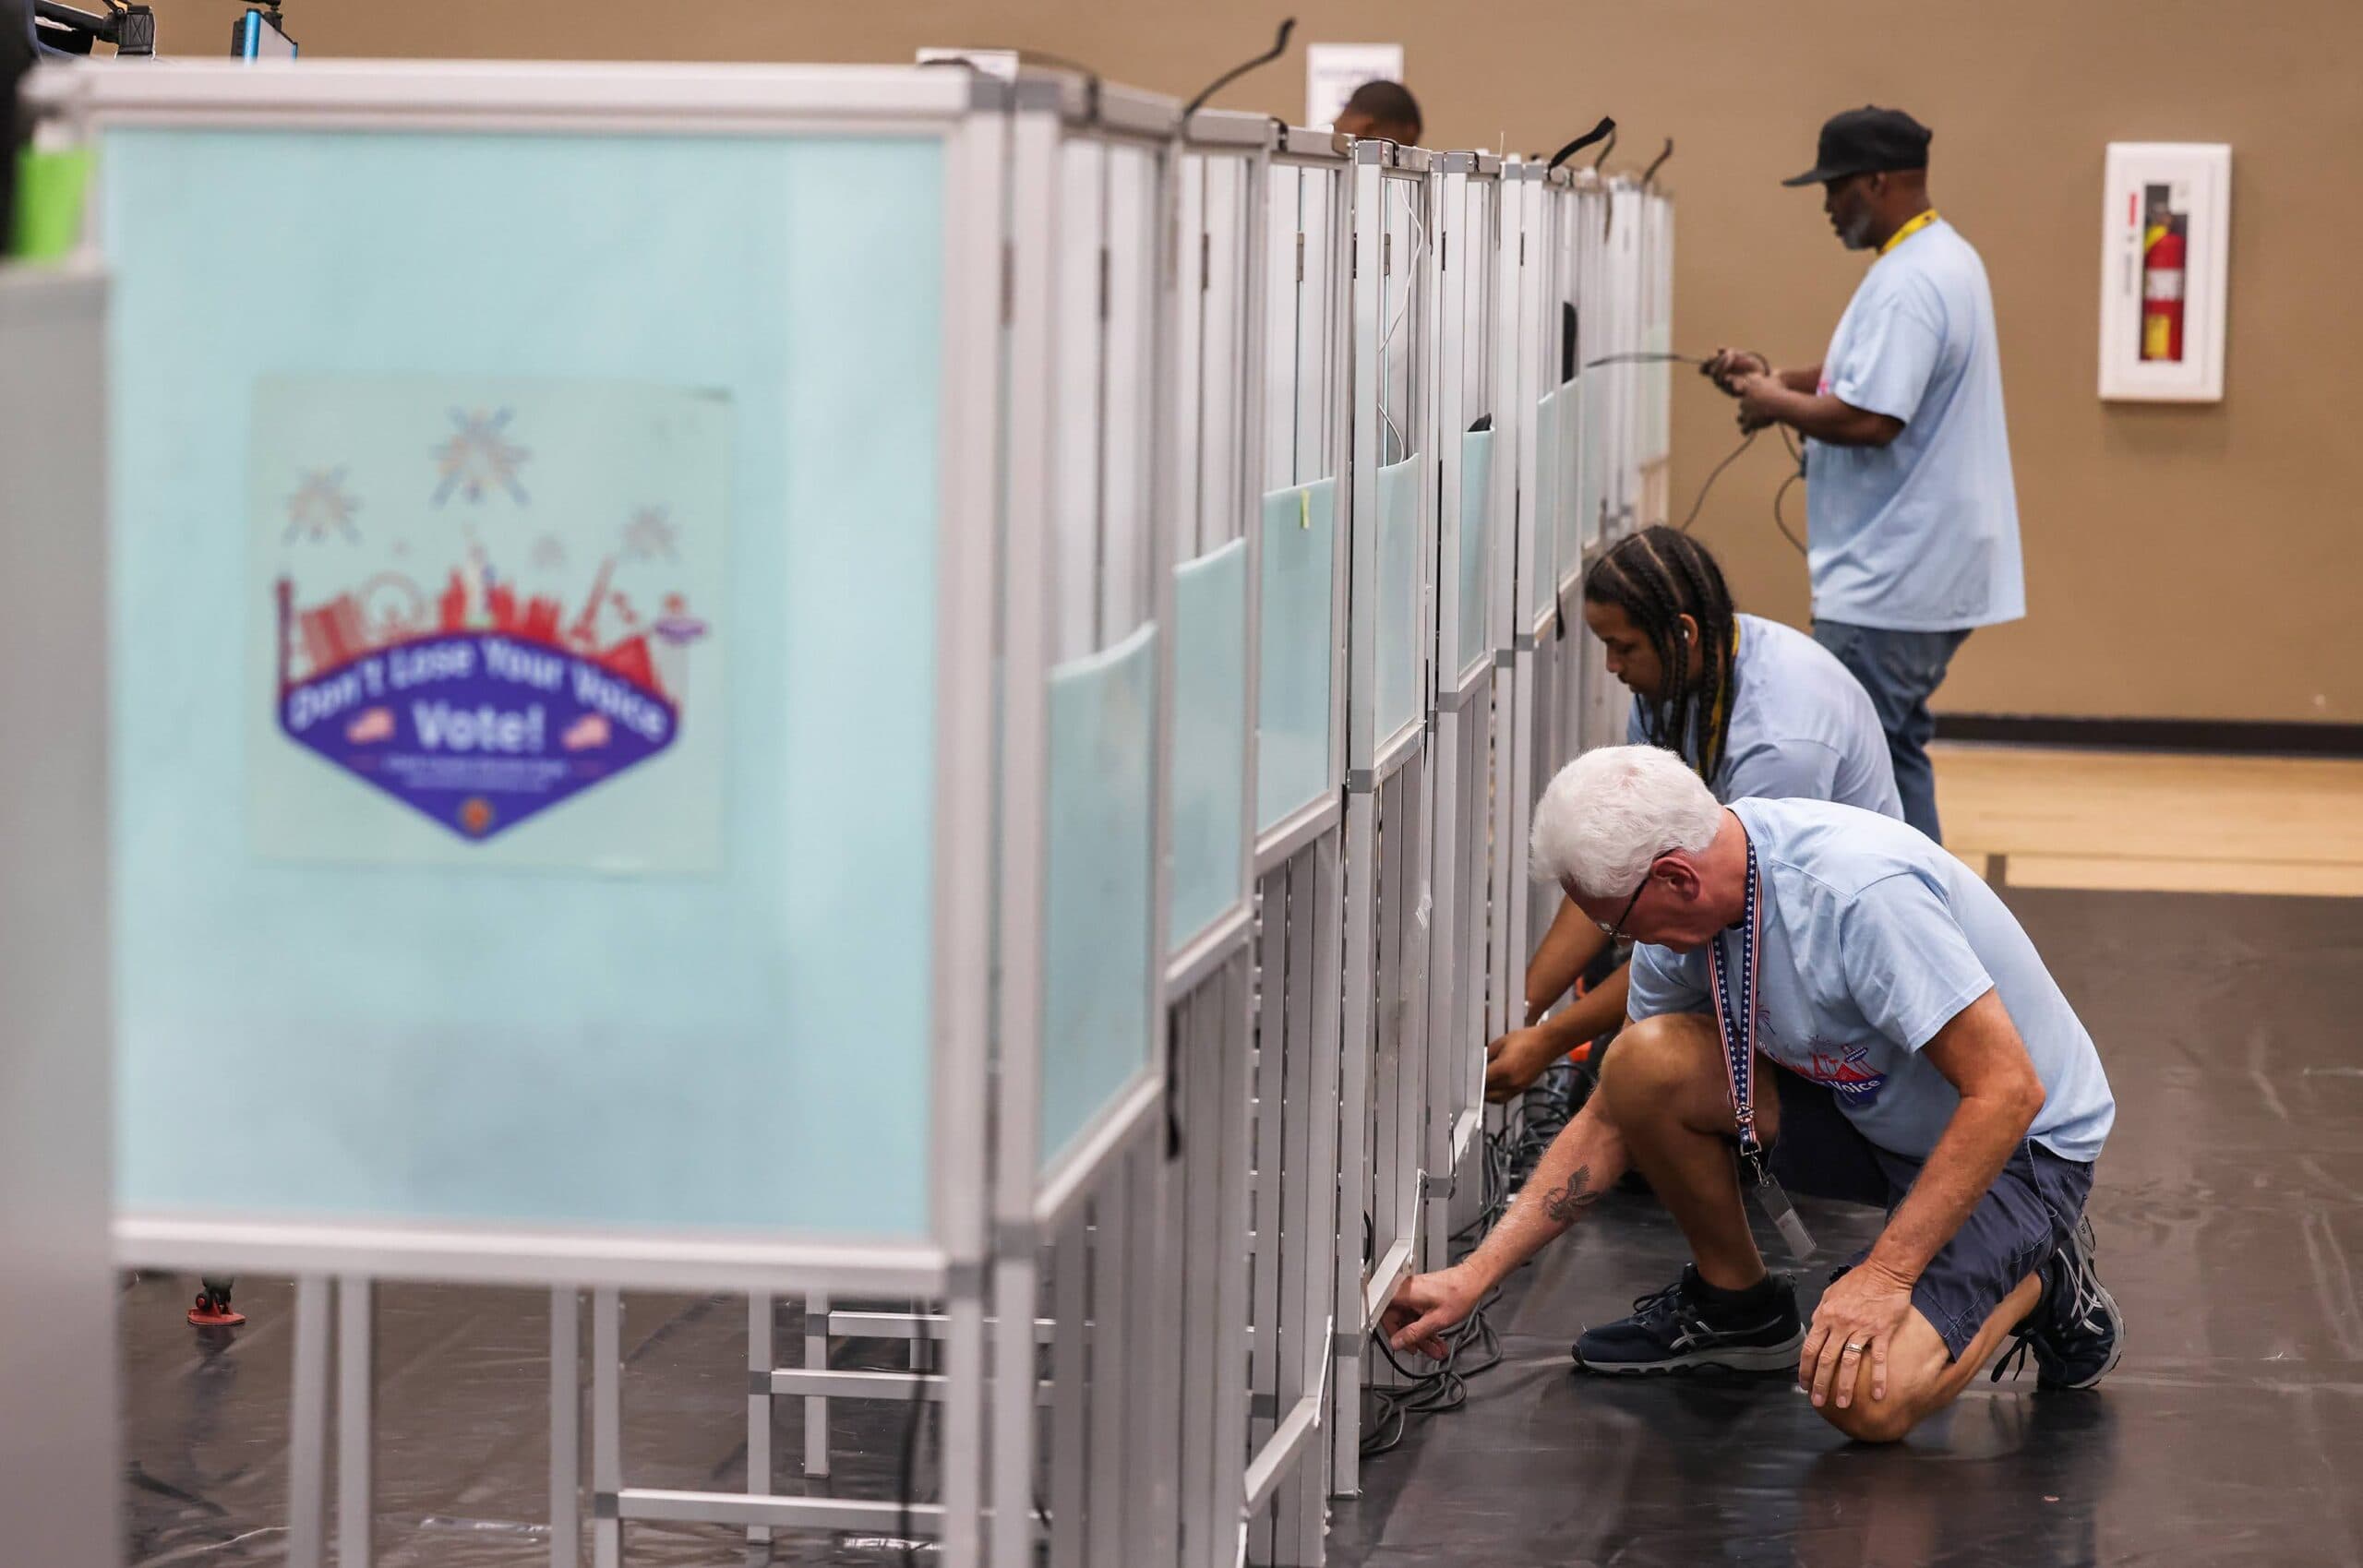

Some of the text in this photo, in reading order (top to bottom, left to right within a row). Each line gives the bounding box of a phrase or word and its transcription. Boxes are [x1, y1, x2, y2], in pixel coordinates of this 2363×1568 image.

[389, 641, 474, 688] Lose
[482, 639, 564, 690] Your
[571, 662, 667, 741] Voice
[412, 700, 546, 753] Vote!
[1828, 1080, 1881, 1094] Voice
